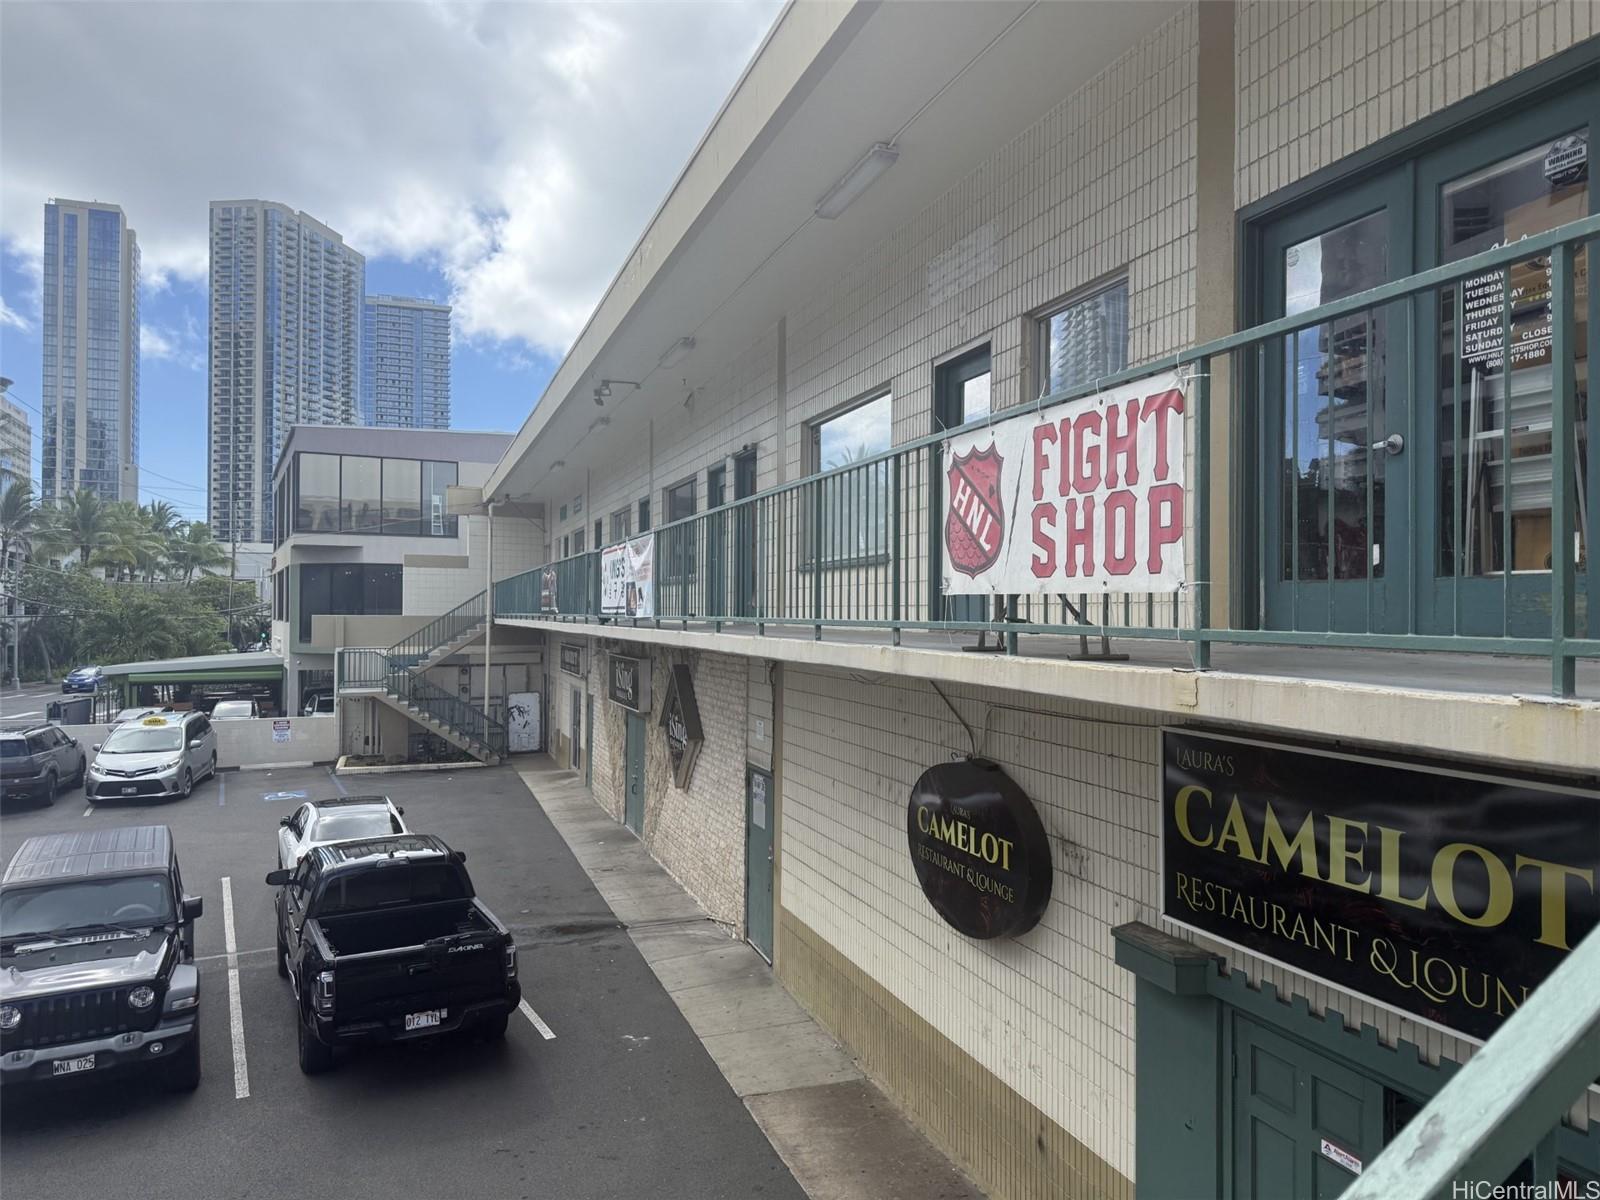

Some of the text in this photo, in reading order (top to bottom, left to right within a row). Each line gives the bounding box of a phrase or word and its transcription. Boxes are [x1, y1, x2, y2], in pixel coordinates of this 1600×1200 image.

[1548, 147, 1583, 167] WARNING
[1465, 270, 1504, 289] MONDAY
[1465, 281, 1504, 299] TUESDA
[1465, 287, 1525, 310] WEDNESAY
[1465, 301, 1517, 321] THURSDY
[1465, 317, 1499, 332] FRIDAY
[1465, 323, 1516, 342] SATURDY
[1465, 325, 1552, 353] SUNDAY CLOSE
[1510, 348, 1546, 363] 17-1880
[1032, 388, 1184, 501] FIGHT
[953, 477, 992, 551] HNL
[1031, 483, 1184, 578] SHOP
[1176, 747, 1235, 776] LAURA'S
[917, 806, 1014, 871] CAMELOT
[918, 844, 1014, 904] RESTAURANT & LOUNGE
[1174, 785, 1595, 952] CAMELOT
[1176, 872, 1530, 1018] RESTAURANT & LOUN
[77, 1057, 94, 1070] 025
